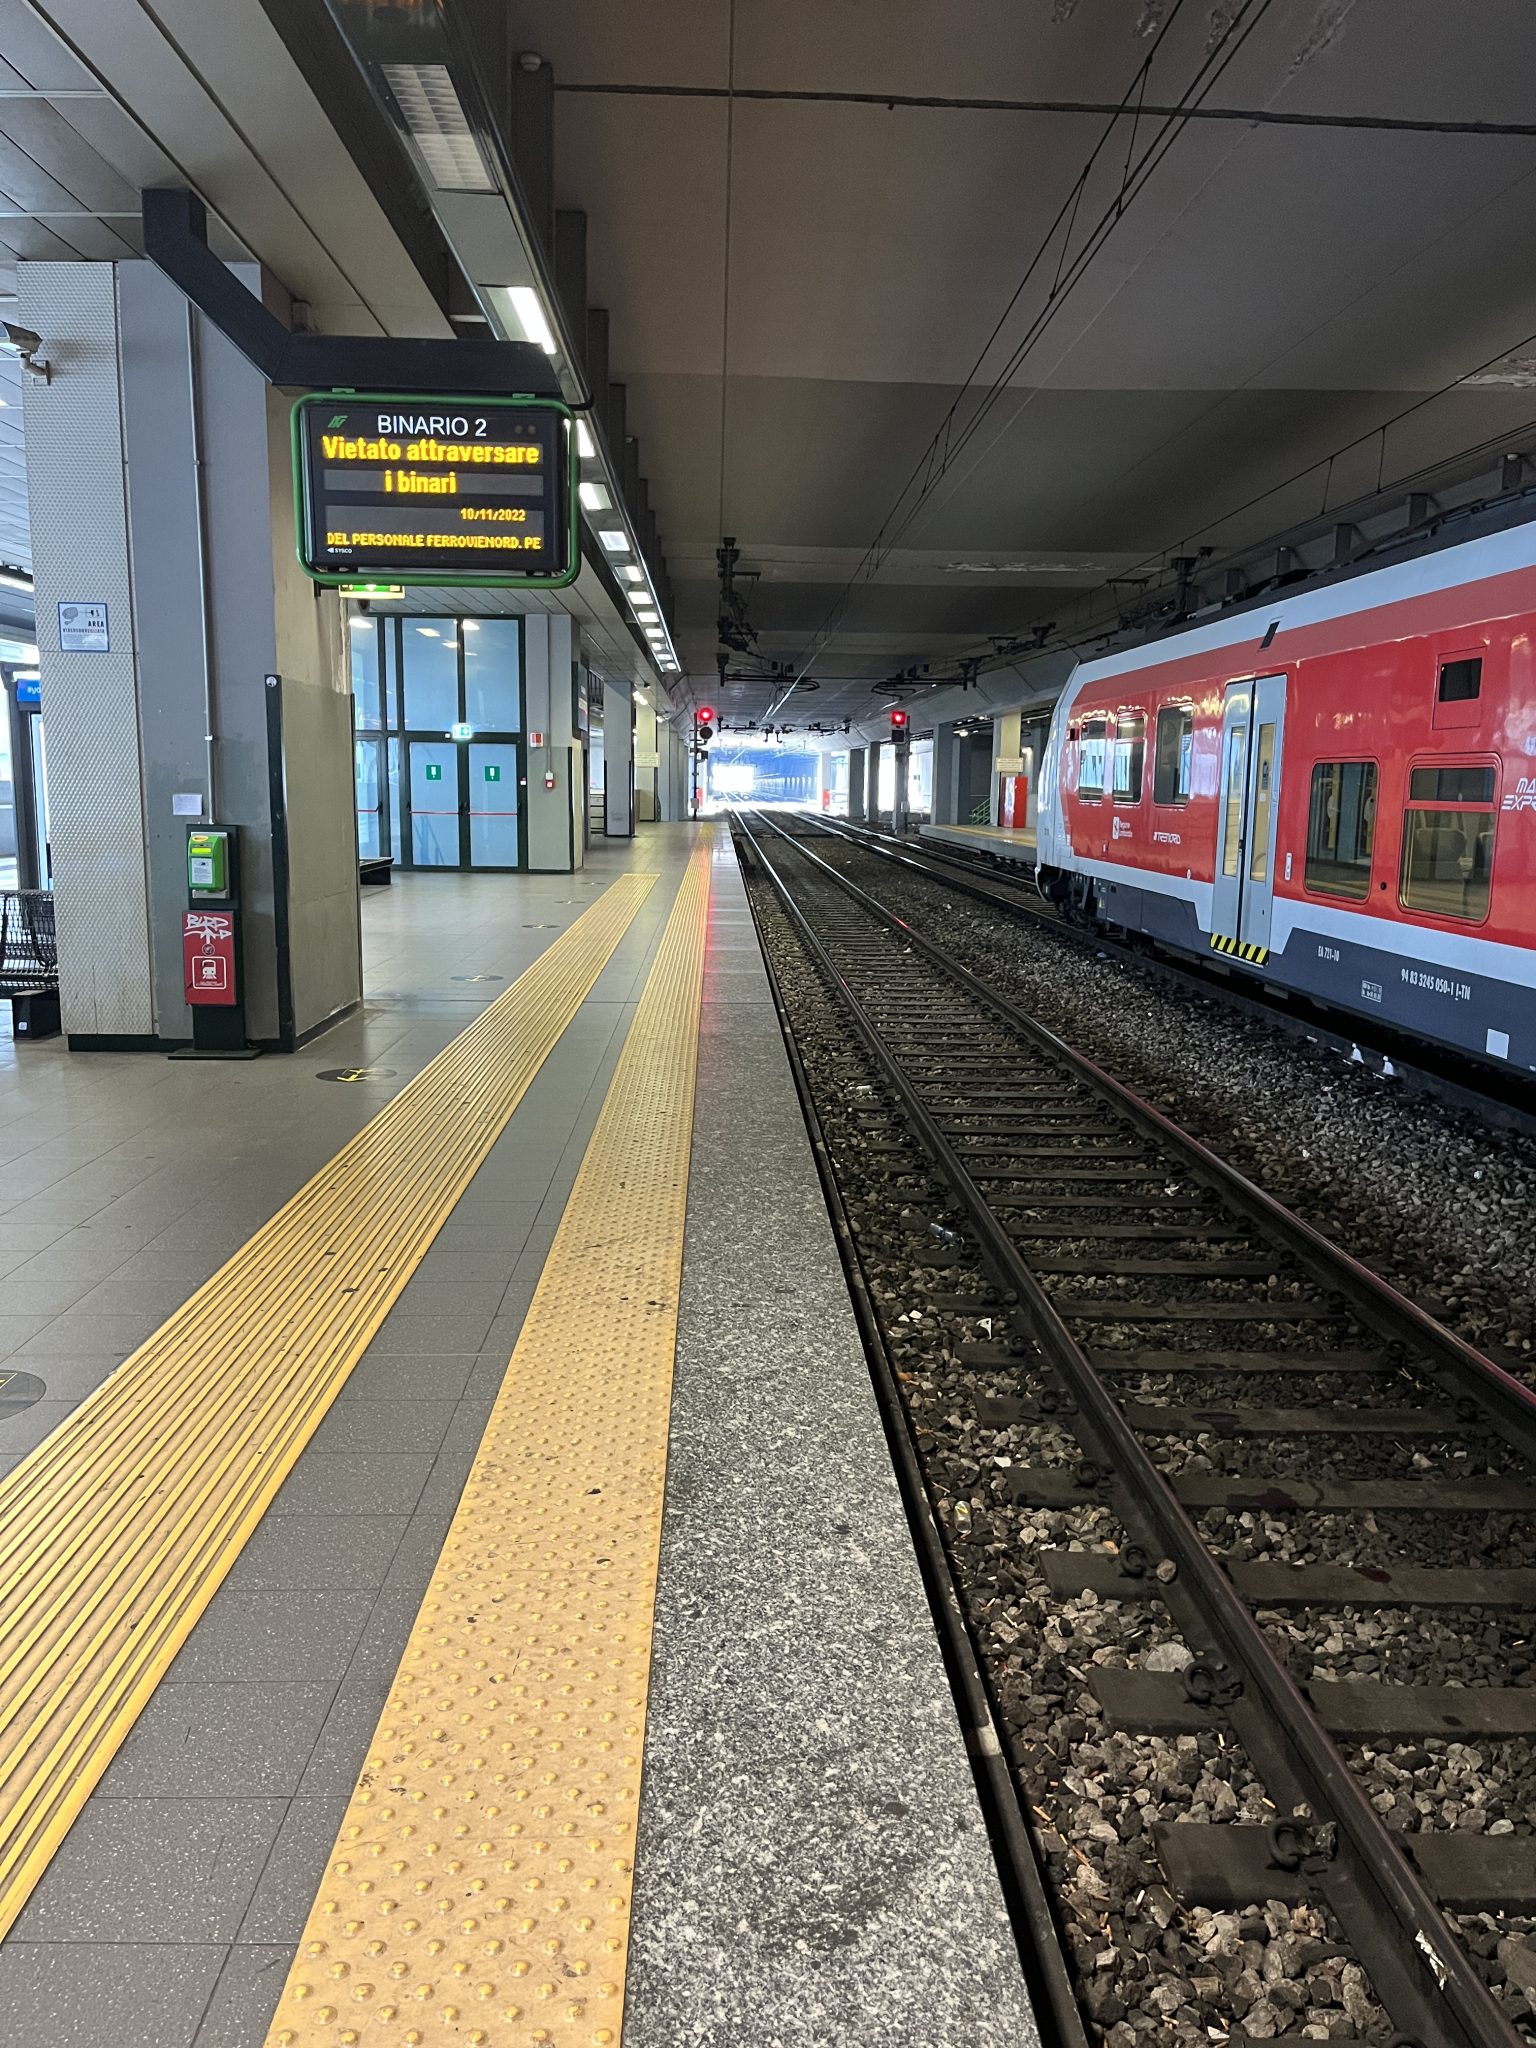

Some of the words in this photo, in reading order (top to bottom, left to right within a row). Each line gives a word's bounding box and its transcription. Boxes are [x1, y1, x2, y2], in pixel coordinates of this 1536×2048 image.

[377, 415, 469, 436] BINARIO
[474, 418, 487, 437] 2
[322, 436, 401, 460] Vietato
[406, 438, 540, 464] attraversare
[384, 469, 393, 493] i
[397, 470, 457, 494] binari
[460, 508, 526, 521] 10/11/2022
[326, 532, 350, 545] DEL
[351, 533, 425, 547] PERSONALE
[524, 536, 542, 549] PE
[1401, 968, 1409, 983] 94
[1409, 970, 1418, 985] 83
[1418, 973, 1435, 990] 3245
[1435, 978, 1454, 996] 050-1
